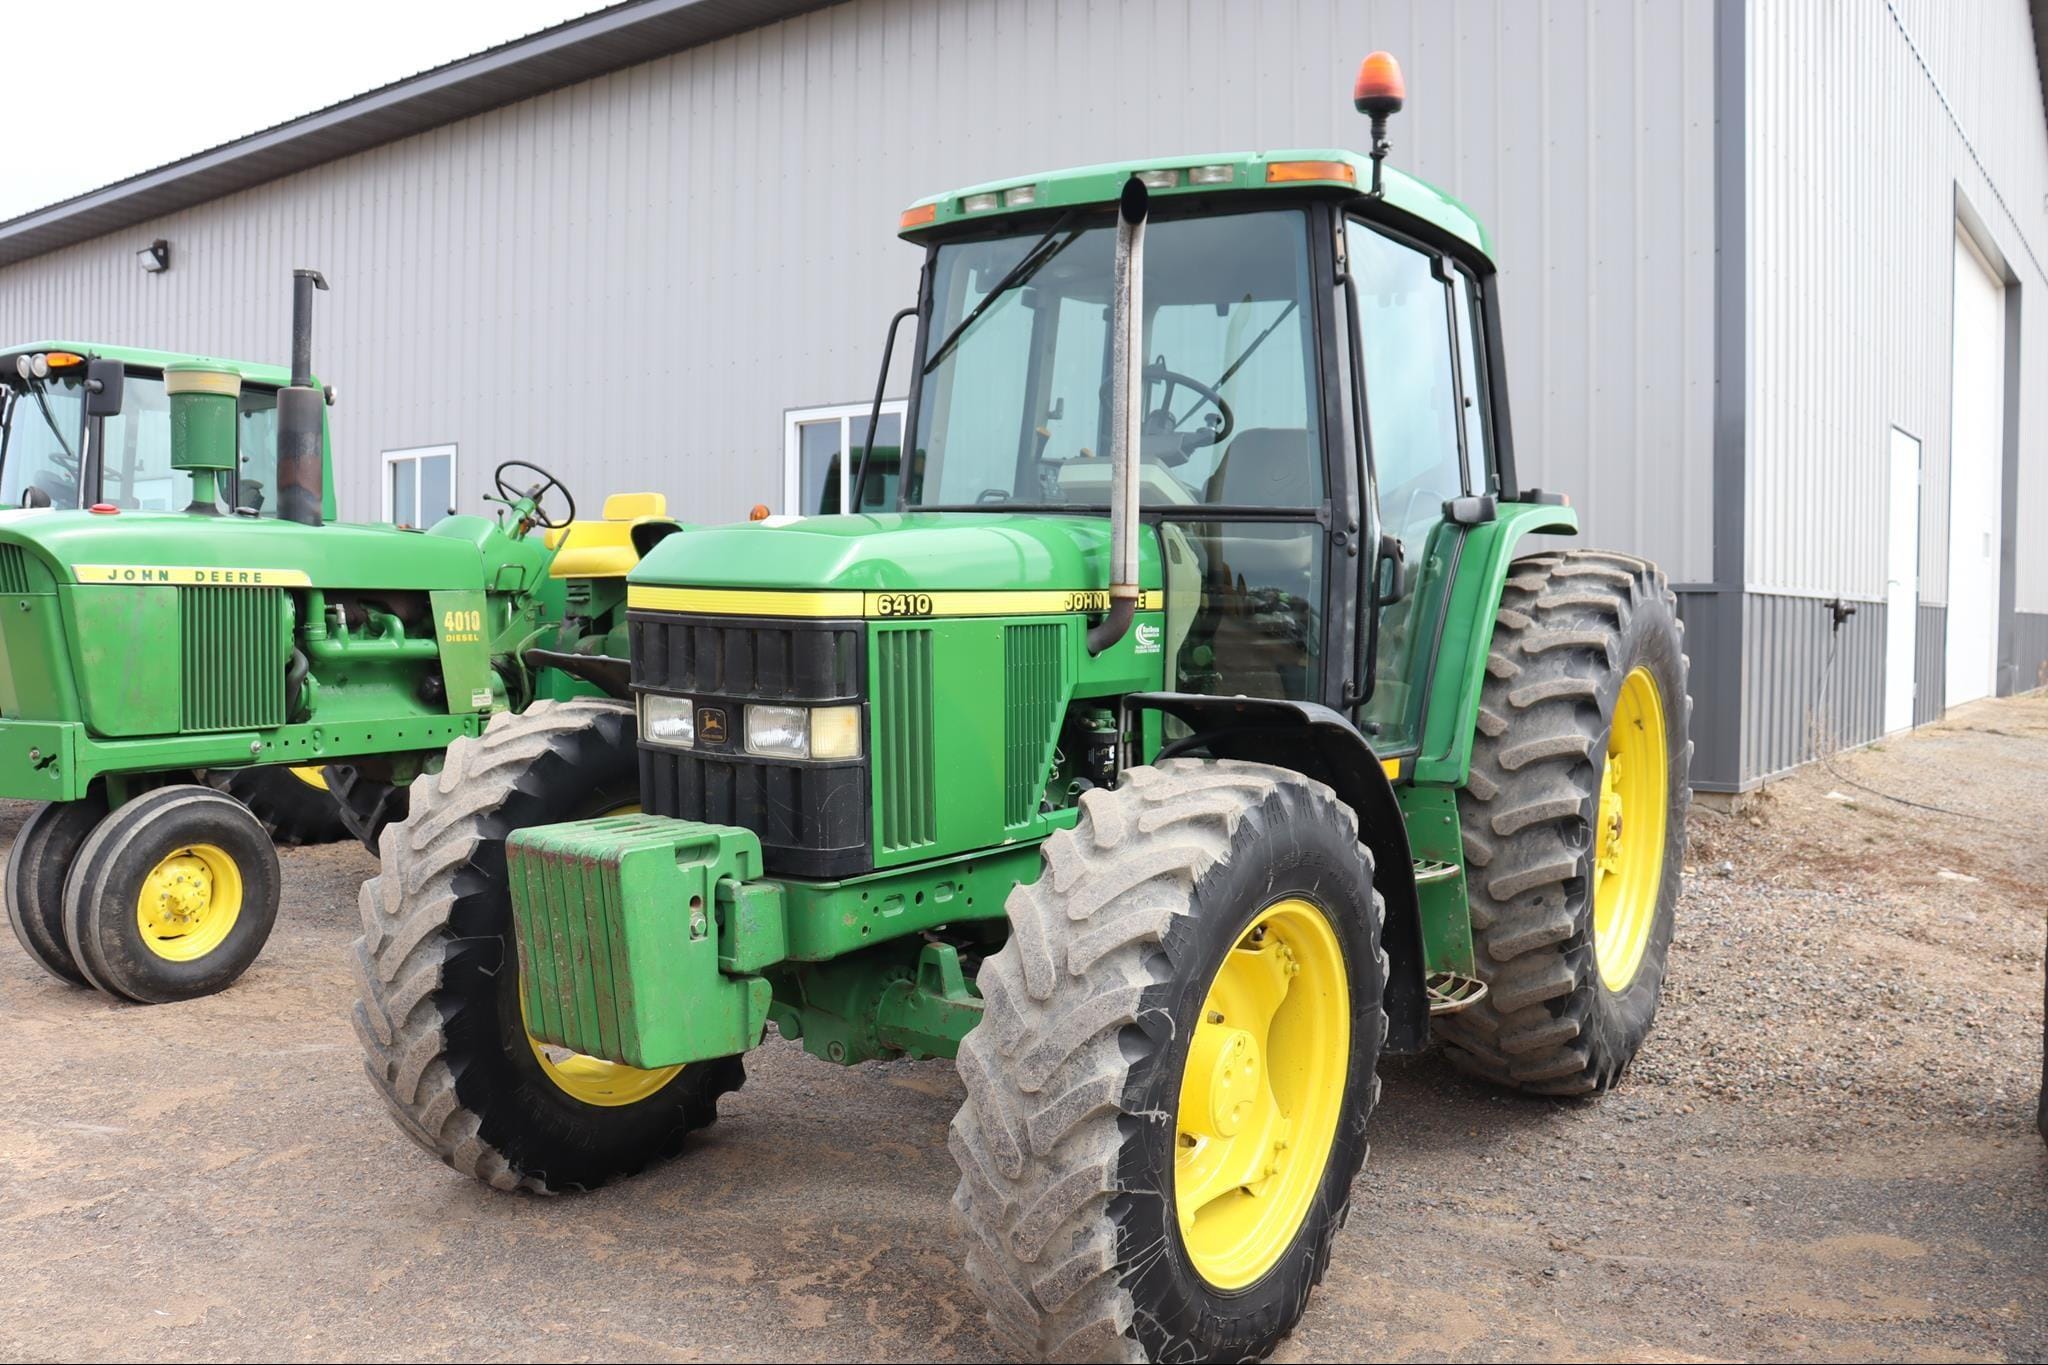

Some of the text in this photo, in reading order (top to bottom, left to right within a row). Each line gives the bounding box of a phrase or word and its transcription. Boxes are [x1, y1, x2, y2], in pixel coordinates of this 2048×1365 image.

[107, 569, 263, 583] JOHN DEERE
[877, 594, 933, 615] 6410
[1064, 592, 1104, 611] JOHN
[444, 610, 481, 631] 4010
[446, 633, 480, 642] DIESEL
